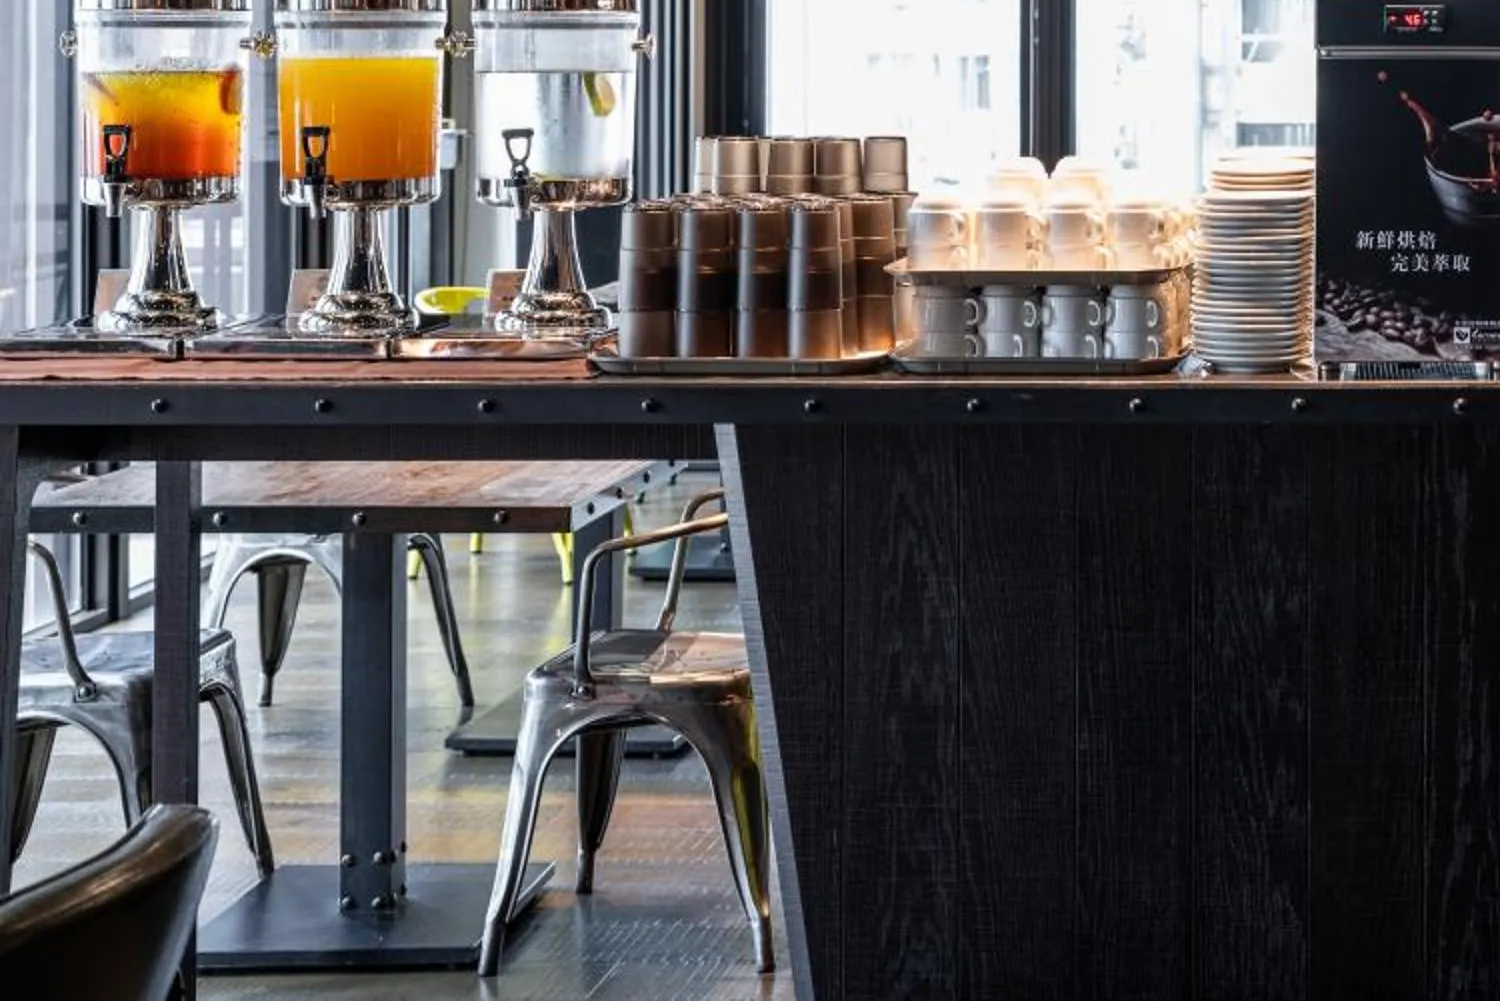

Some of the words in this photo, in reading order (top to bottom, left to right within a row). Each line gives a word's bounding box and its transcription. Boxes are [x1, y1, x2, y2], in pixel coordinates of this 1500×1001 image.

[1356, 230, 1436, 250] 新鮮烘焙
[1391, 253, 1470, 272] 完美萃取
